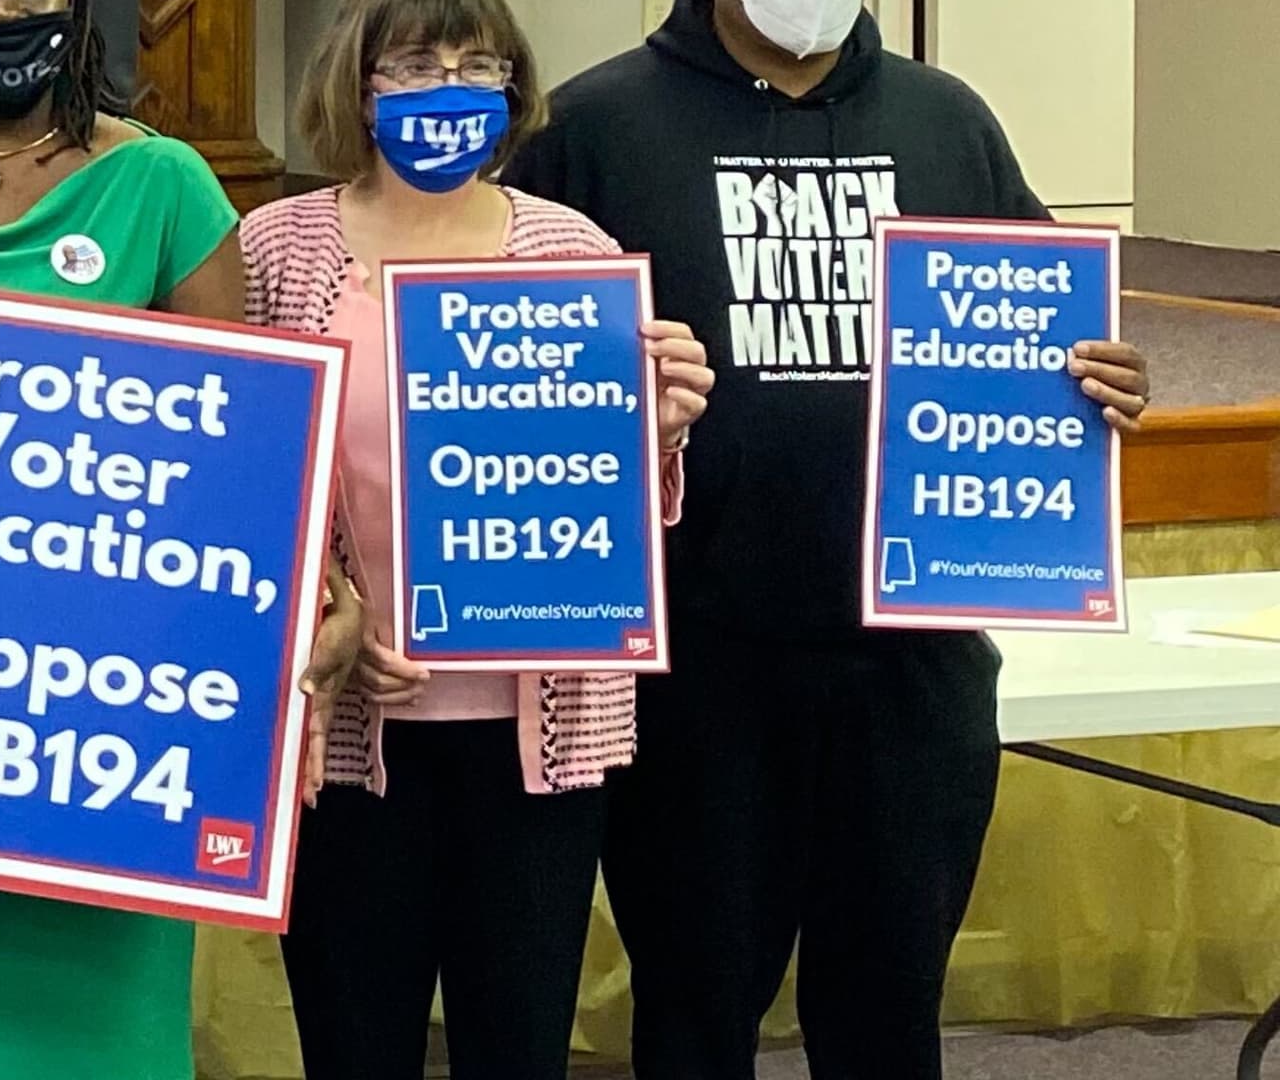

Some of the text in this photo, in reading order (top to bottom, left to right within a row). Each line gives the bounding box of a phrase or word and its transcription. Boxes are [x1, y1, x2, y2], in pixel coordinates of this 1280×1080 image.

[724, 238, 873, 300] VOTER
[926, 250, 1071, 294] Protect
[440, 292, 598, 331] Protect
[941, 291, 1057, 332] Voter
[458, 331, 584, 371] Voter
[890, 327, 1074, 371] Educatio
[407, 372, 637, 414] Education,
[907, 400, 1084, 453] Oppose
[429, 445, 620, 495] Oppose
[913, 474, 1076, 520] HB194
[442, 516, 613, 562] HB194
[929, 560, 1104, 582] #YourVoteIsYourVoice
[461, 603, 645, 623] #YourVoteIsYourVoice
[206, 833, 248, 860] LWV
